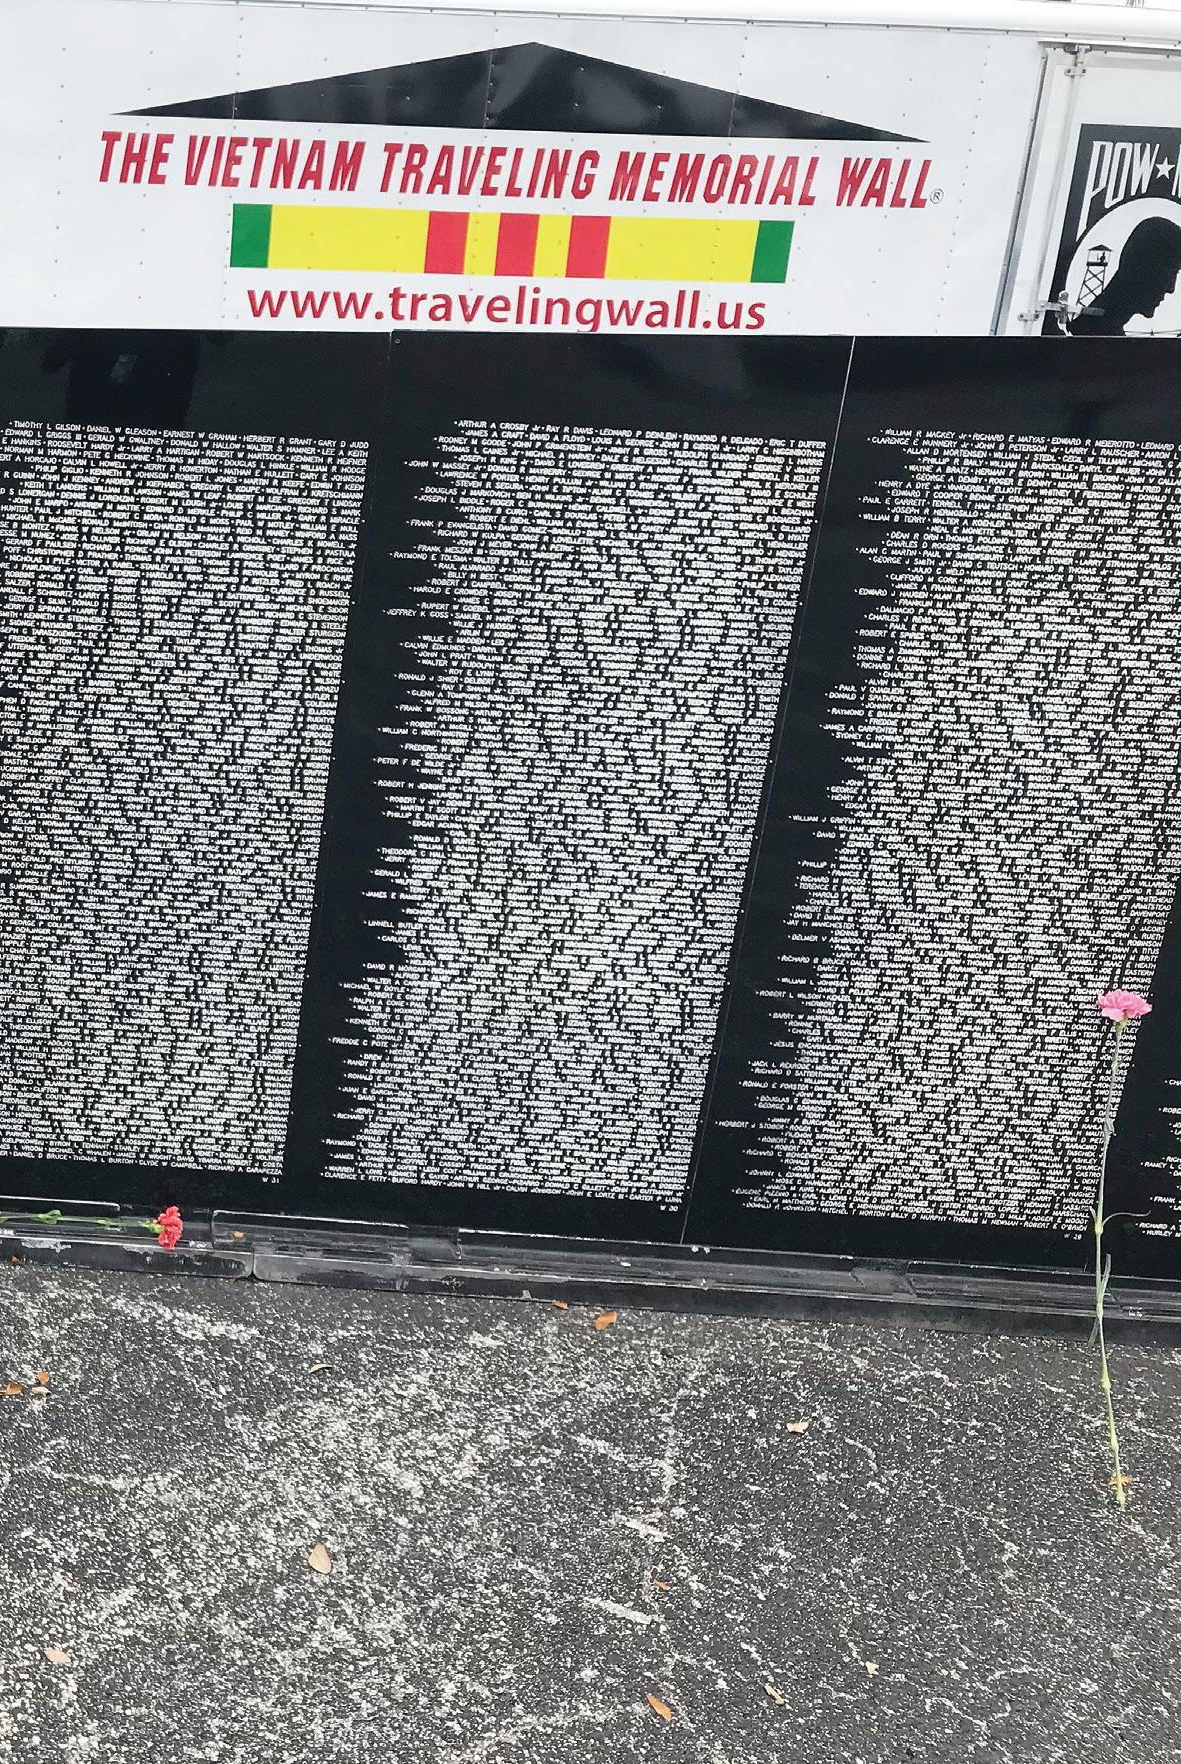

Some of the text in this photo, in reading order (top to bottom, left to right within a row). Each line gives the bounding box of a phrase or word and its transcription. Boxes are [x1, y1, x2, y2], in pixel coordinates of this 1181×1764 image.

[98, 130, 932, 209] THE VIETNAM TRAVELING MEMORIAL WALL
[247, 284, 766, 332] www.travelingwall.us
[14, 421, 43, 429] TIMOTHY
[87, 425, 111, 433] DANIEL
[125, 428, 157, 436] GLEASON
[163, 430, 195, 439] EARNEST
[209, 433, 237, 441] GRAHAM
[243, 435, 276, 443] HERBERT
[289, 438, 312, 446] GRANT
[350, 441, 368, 449] JUDD
[458, 420, 486, 429] ARTHUR
[500, 423, 528, 431] CROSBY
[683, 434, 717, 442] RAYMOND
[731, 437, 763, 445] DELGADO
[769, 439, 785, 447] ERIC
[885, 429, 912, 437] WILLIAM
[973, 433, 1004, 441] RICHARD
[1018, 435, 1045, 443] MATYAS
[1051, 437, 1081, 445] EDWARD
[1141, 442, 1174, 450] LEONARD
